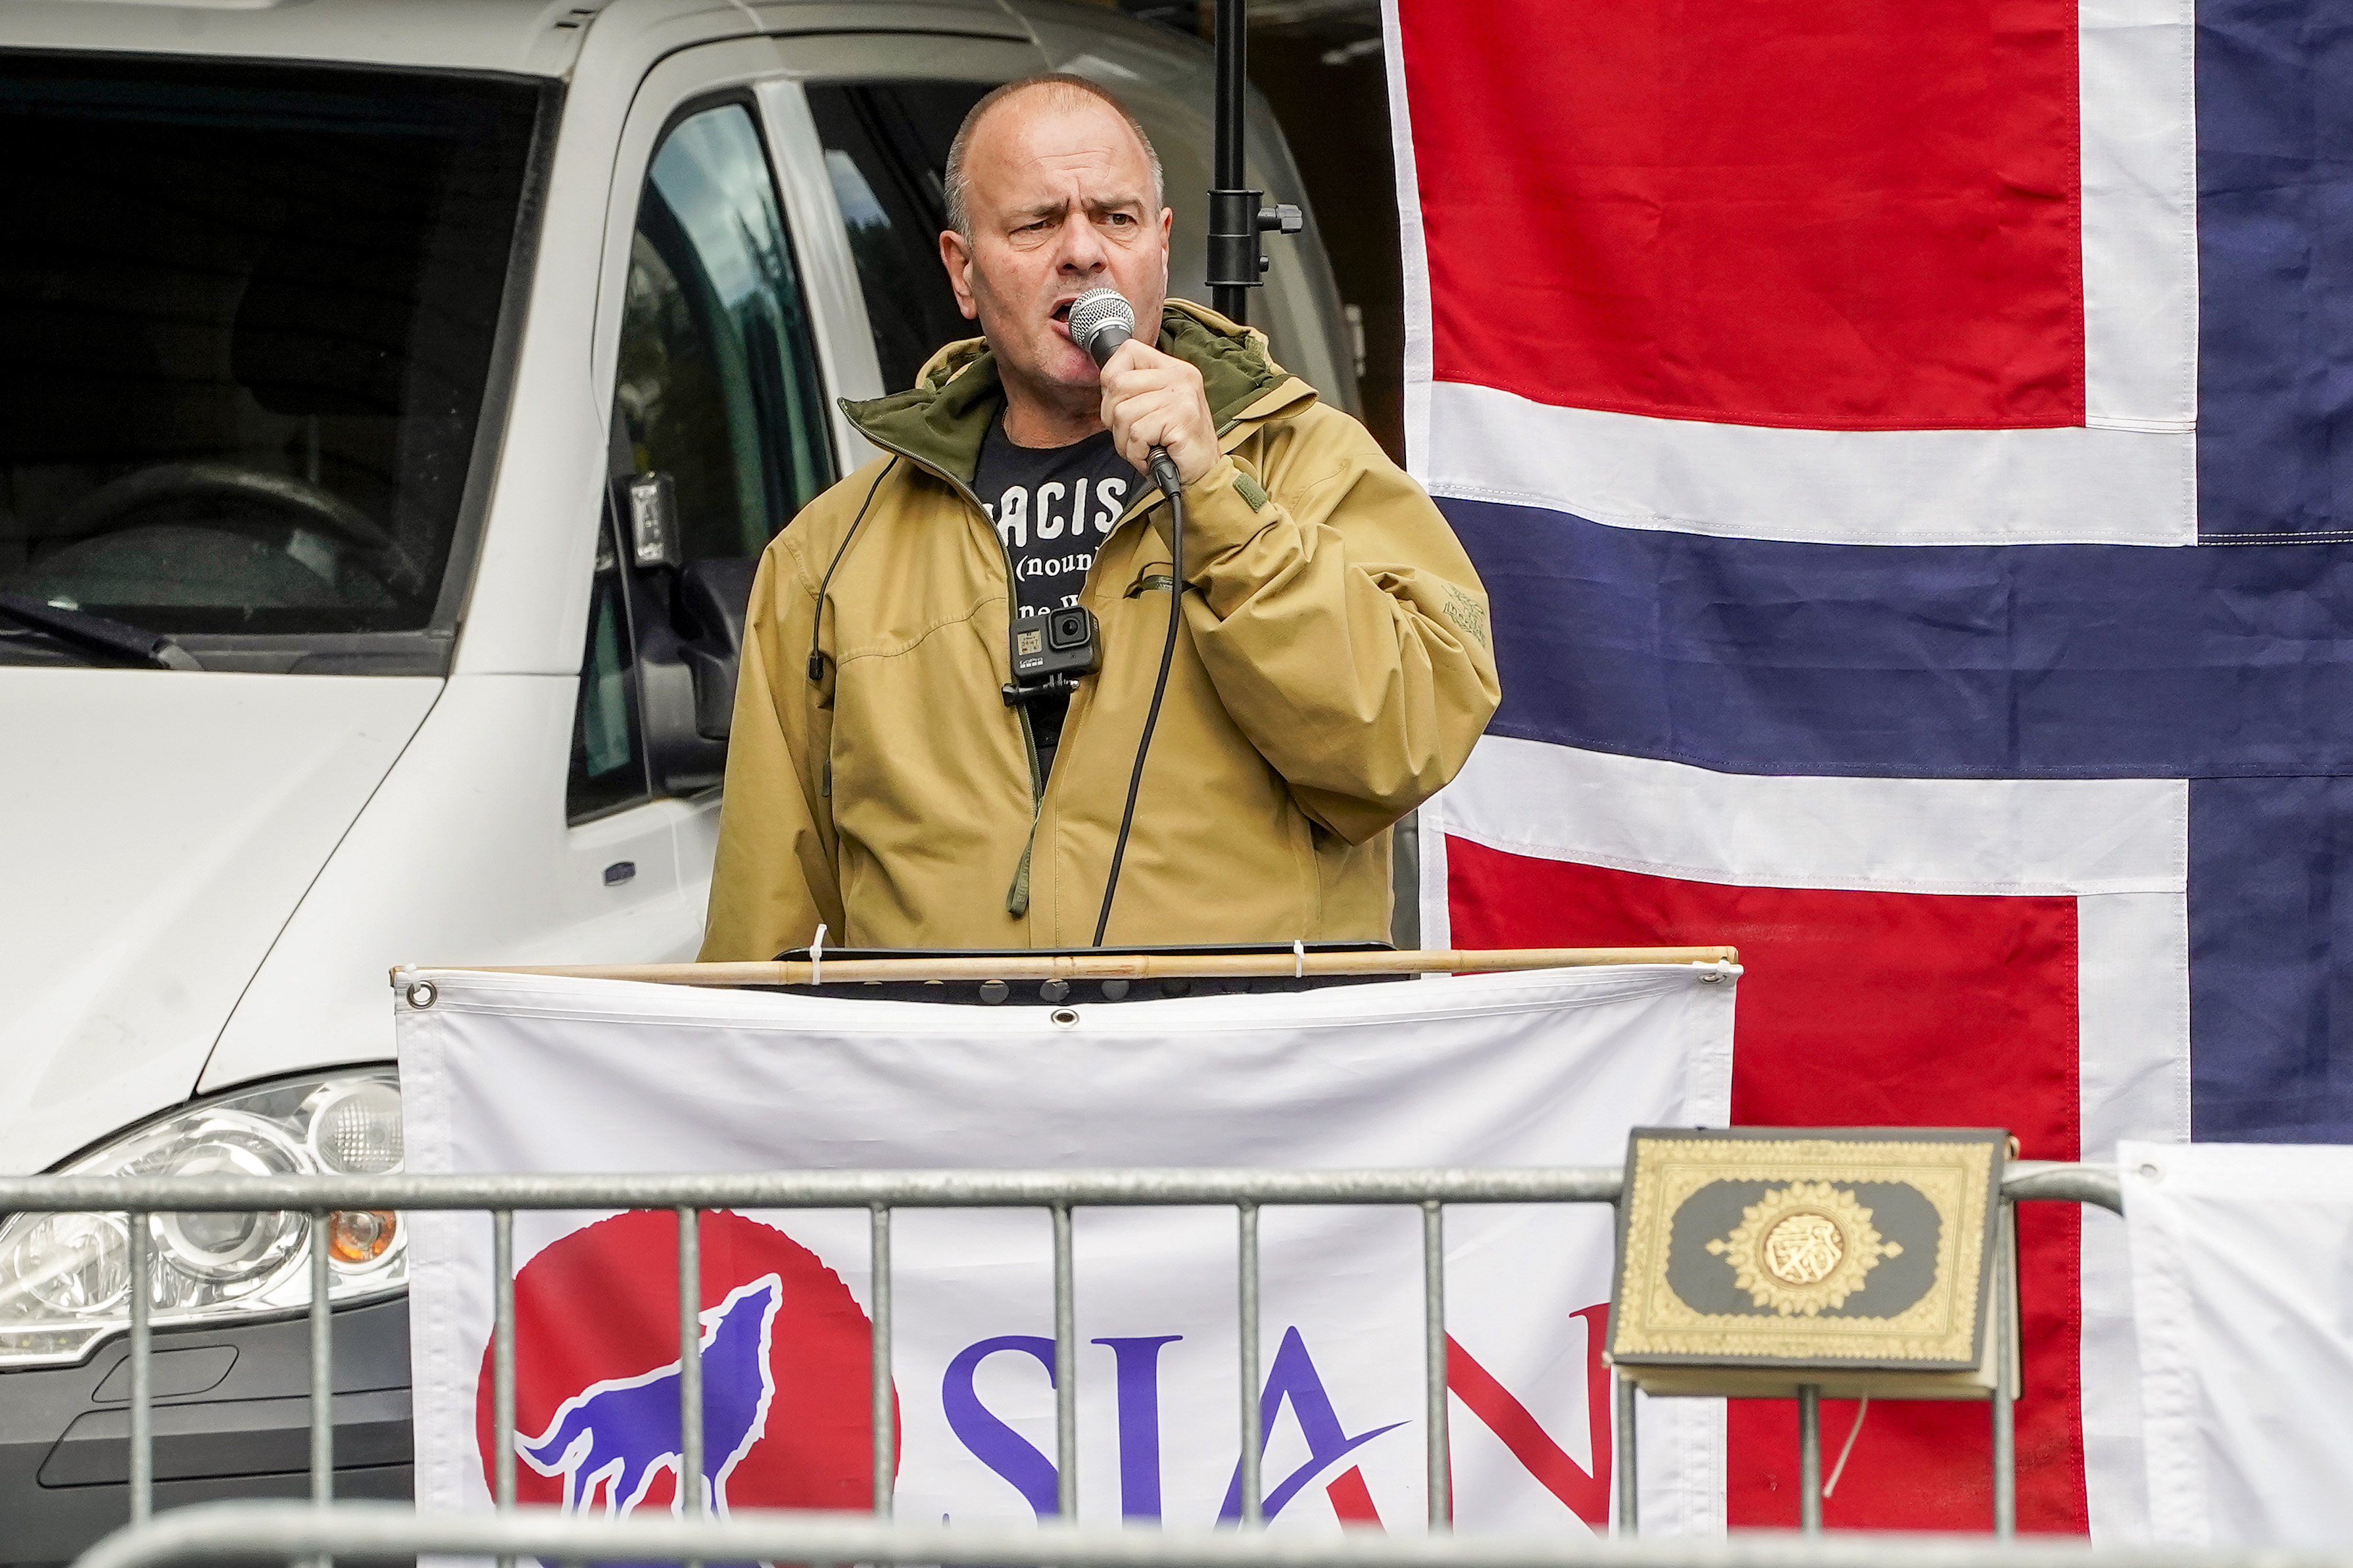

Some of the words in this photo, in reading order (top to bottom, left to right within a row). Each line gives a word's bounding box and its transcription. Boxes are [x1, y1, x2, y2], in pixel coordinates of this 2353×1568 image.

[982, 477, 1127, 548] ACIS
[1016, 546, 1100, 582] (noun
[942, 1302, 1613, 1565] SIAN
